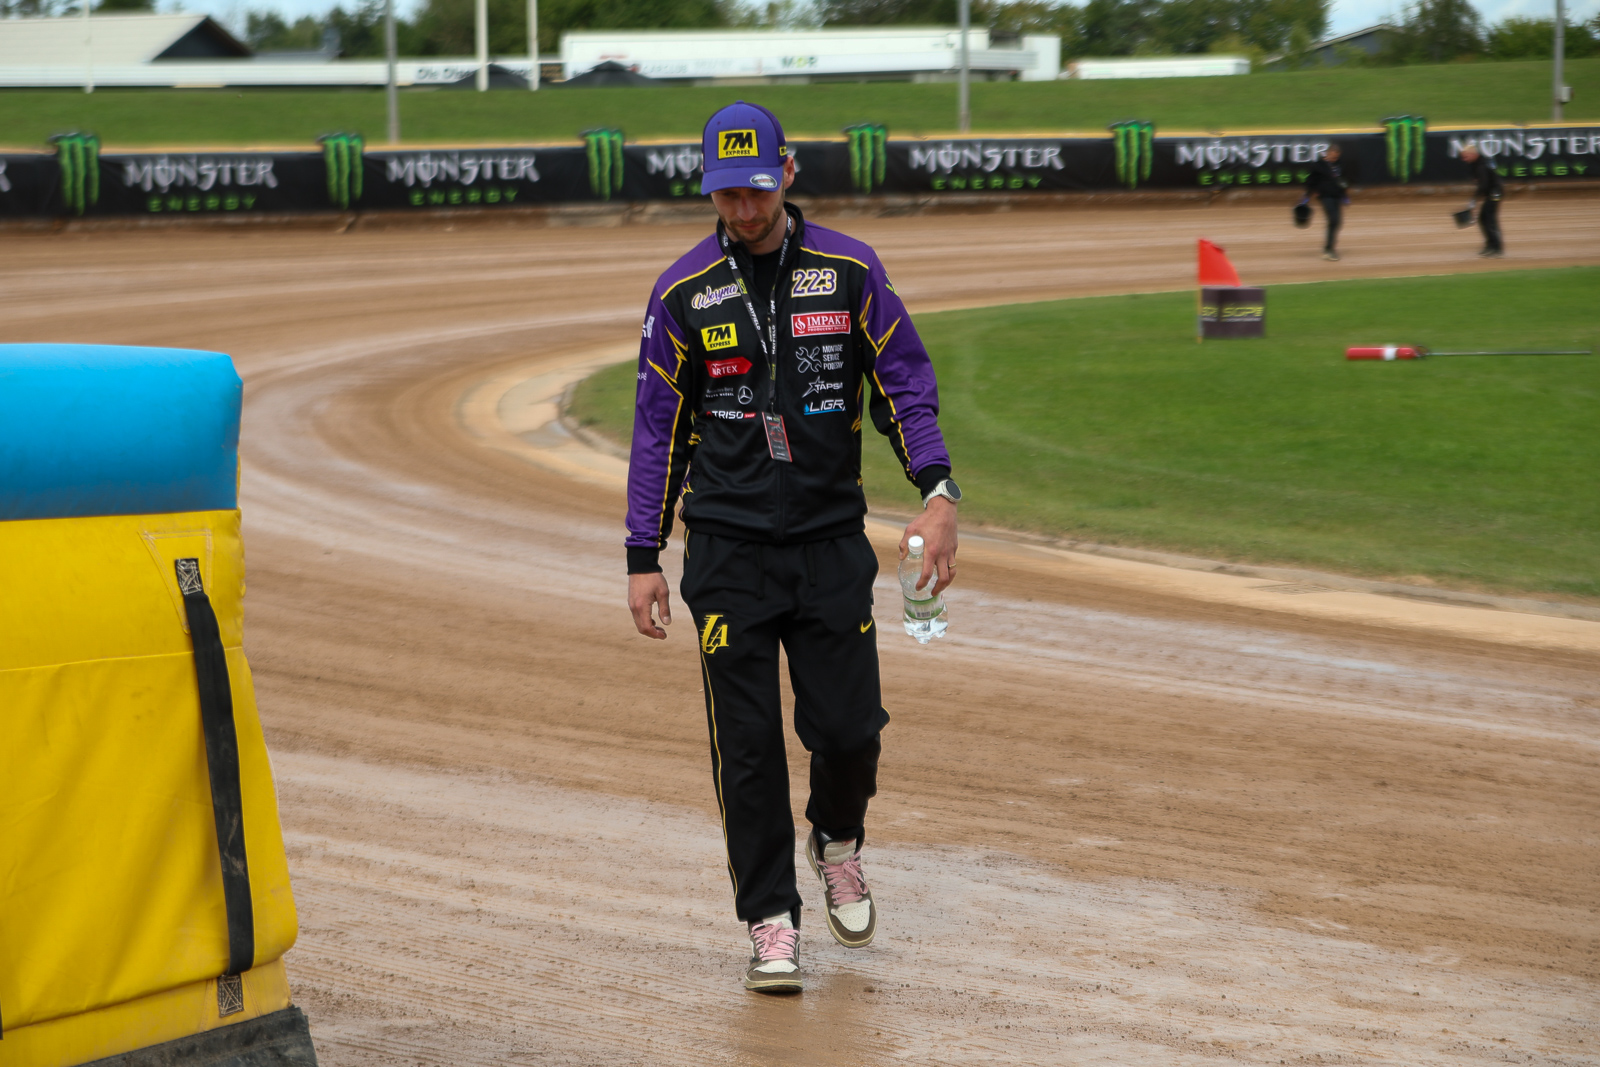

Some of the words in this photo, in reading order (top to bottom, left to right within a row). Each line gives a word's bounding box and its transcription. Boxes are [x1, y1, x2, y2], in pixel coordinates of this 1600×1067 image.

[723, 132, 753, 151] TM
[908, 142, 1065, 174] MONSTER
[1174, 139, 1330, 170] MONSTER
[122, 153, 278, 194] MONSTER
[386, 152, 540, 188] MONSTER
[1199, 171, 1311, 185] ENERGY
[931, 174, 1043, 190] ENERGY
[147, 196, 257, 213] ENERGY
[410, 188, 519, 206] ENERGY
[791, 268, 837, 298] 223
[691, 284, 741, 310] Woryna
[746, 302, 761, 331] MAYFIELD
[807, 315, 848, 327] IMPAKT
[707, 326, 732, 343] TM
[712, 411, 744, 419] TRISO
